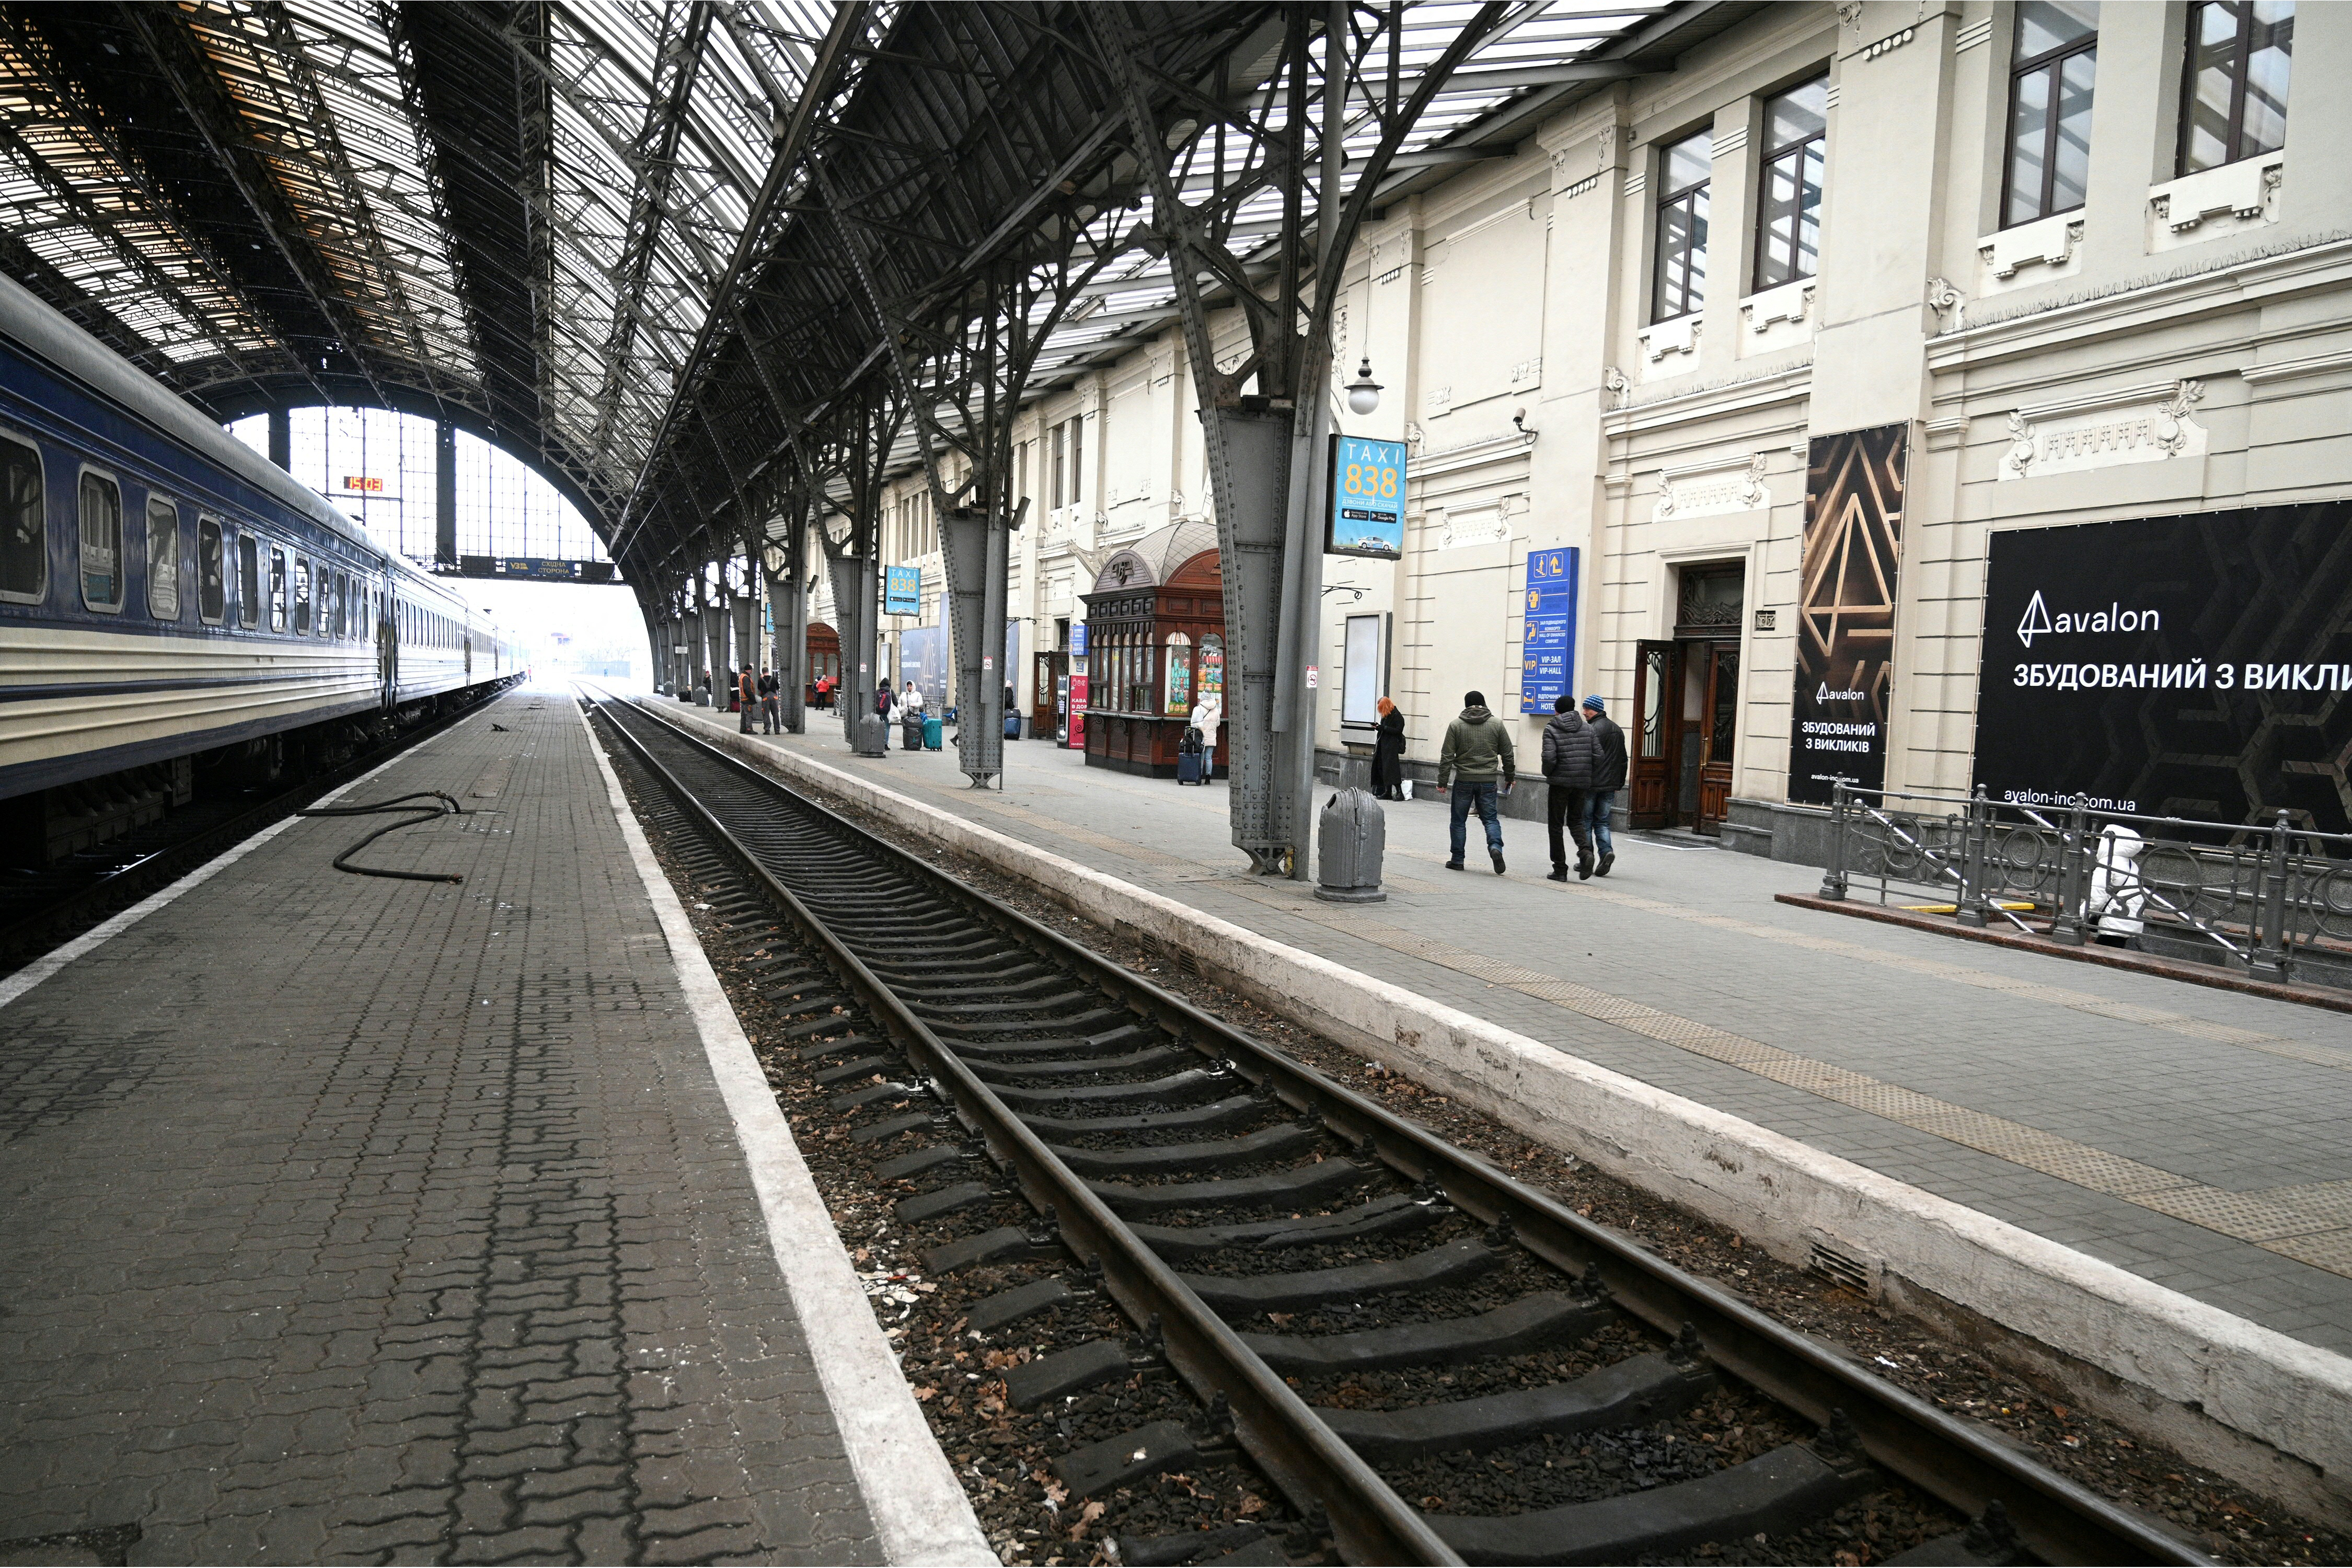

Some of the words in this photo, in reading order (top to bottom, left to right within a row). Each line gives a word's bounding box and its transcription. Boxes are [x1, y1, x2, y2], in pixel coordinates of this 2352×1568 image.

[1347, 443, 1399, 464] TAXI
[1344, 464, 1398, 498] 838
[891, 569, 916, 578] TAXI
[891, 578, 916, 593] 838
[2055, 602, 2159, 633] avalon
[1525, 660, 1536, 670] VIP
[2013, 658, 2206, 691] ЗБУДОВАНИЙ
[2215, 663, 2234, 689] З
[1829, 688, 1864, 700] avalon
[1802, 721, 1875, 736] ЗБУДОВАНИЙ
[1805, 737, 1812, 749] З
[1814, 738, 1870, 753] ВИКЛИКІВ
[1811, 774, 1859, 783] avalon-incom.ua
